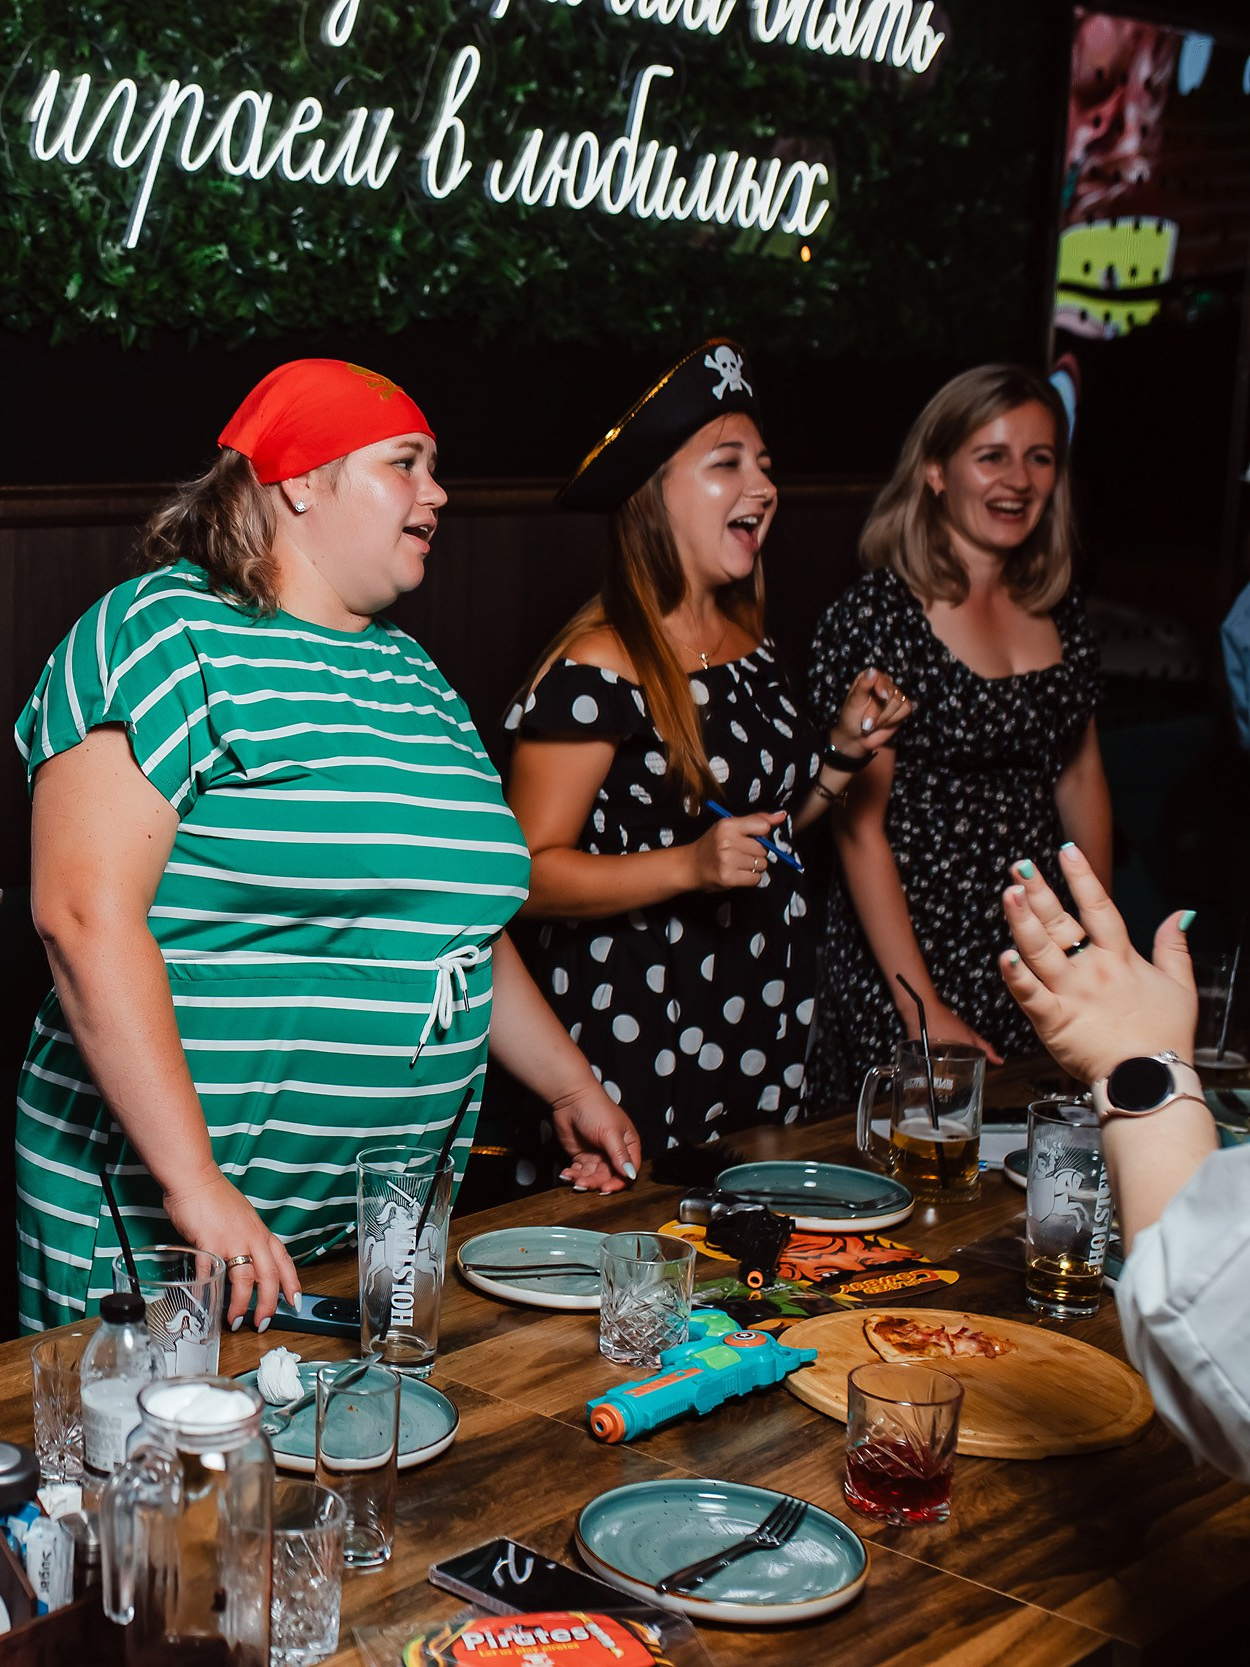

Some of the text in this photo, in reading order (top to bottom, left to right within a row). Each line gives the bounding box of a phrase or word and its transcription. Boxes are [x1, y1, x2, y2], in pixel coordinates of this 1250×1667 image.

[29, 45, 830, 248] играем в любимых
